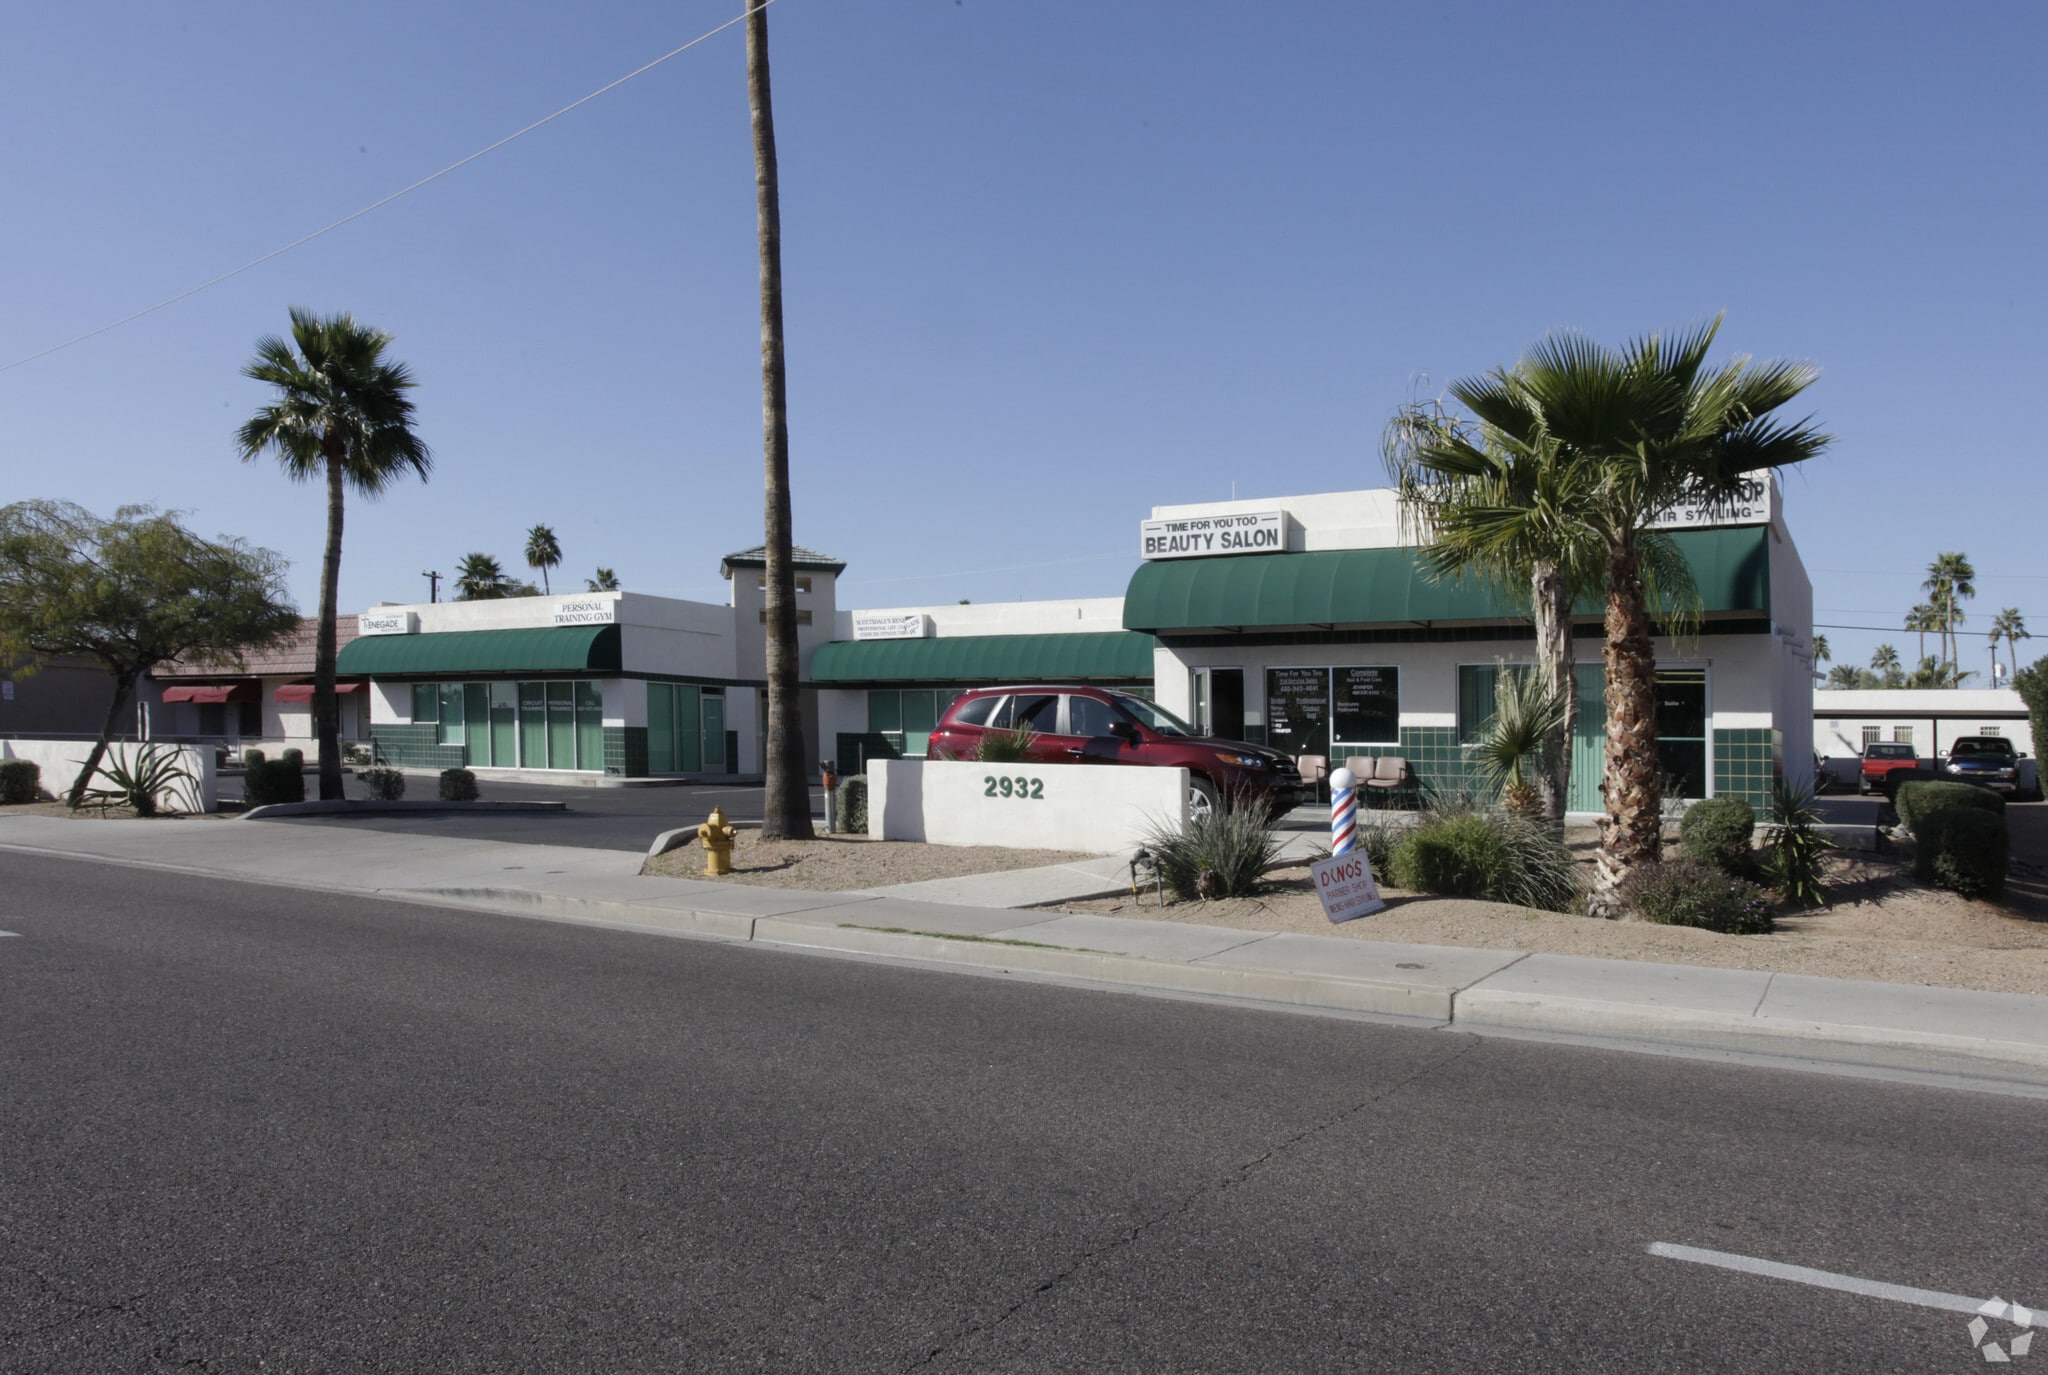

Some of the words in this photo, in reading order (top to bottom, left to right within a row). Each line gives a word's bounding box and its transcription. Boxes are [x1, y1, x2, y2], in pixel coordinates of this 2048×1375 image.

[1685, 507, 1752, 521] STYLING
[1165, 522, 1189, 532] TIME
[1191, 520, 1210, 530] FOR
[1213, 518, 1233, 528] YOU
[1235, 516, 1257, 526] TOO
[1145, 533, 1214, 554] BEAUTY
[1220, 528, 1278, 549] SALON
[562, 602, 603, 612] PERSONAL
[554, 613, 592, 623] TRAINING
[594, 612, 612, 621] GYM
[984, 775, 1044, 799] 2932
